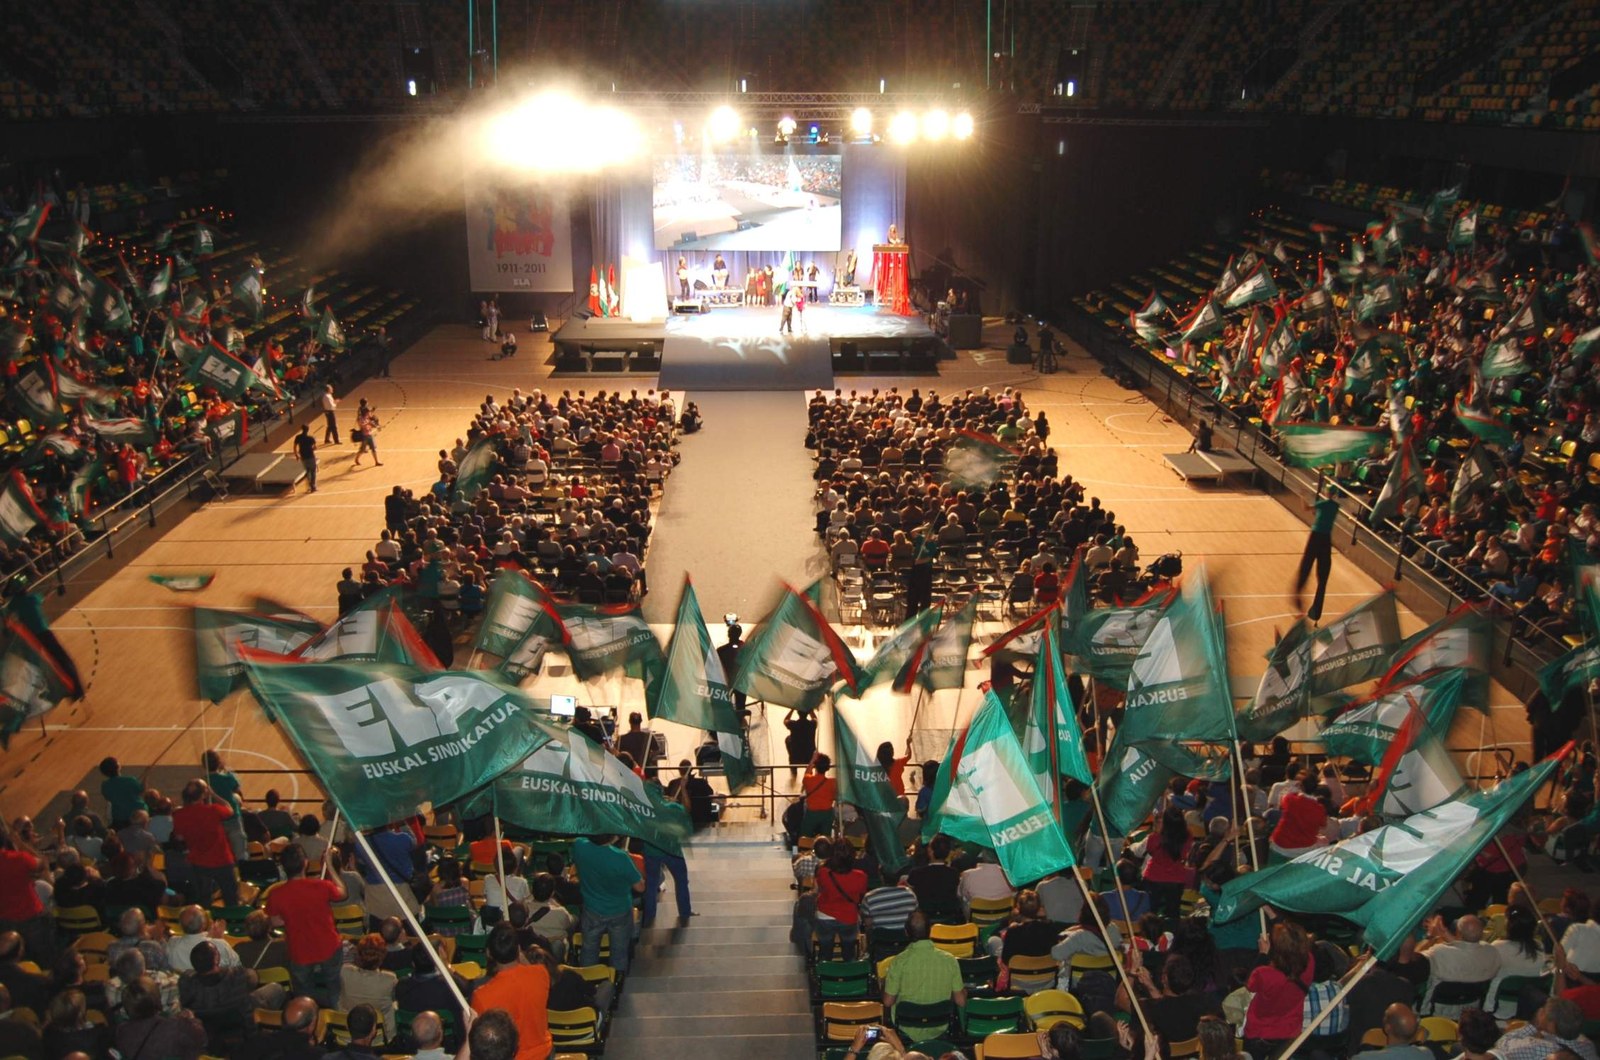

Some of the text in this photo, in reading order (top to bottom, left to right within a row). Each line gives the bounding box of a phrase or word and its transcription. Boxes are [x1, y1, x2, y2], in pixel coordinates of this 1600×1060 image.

[497, 263, 546, 273] 1911-2011
[312, 676, 507, 758] ELA
[362, 701, 521, 779] EUSKAL SINDIKATUA
[521, 776, 578, 797] EUSKAL
